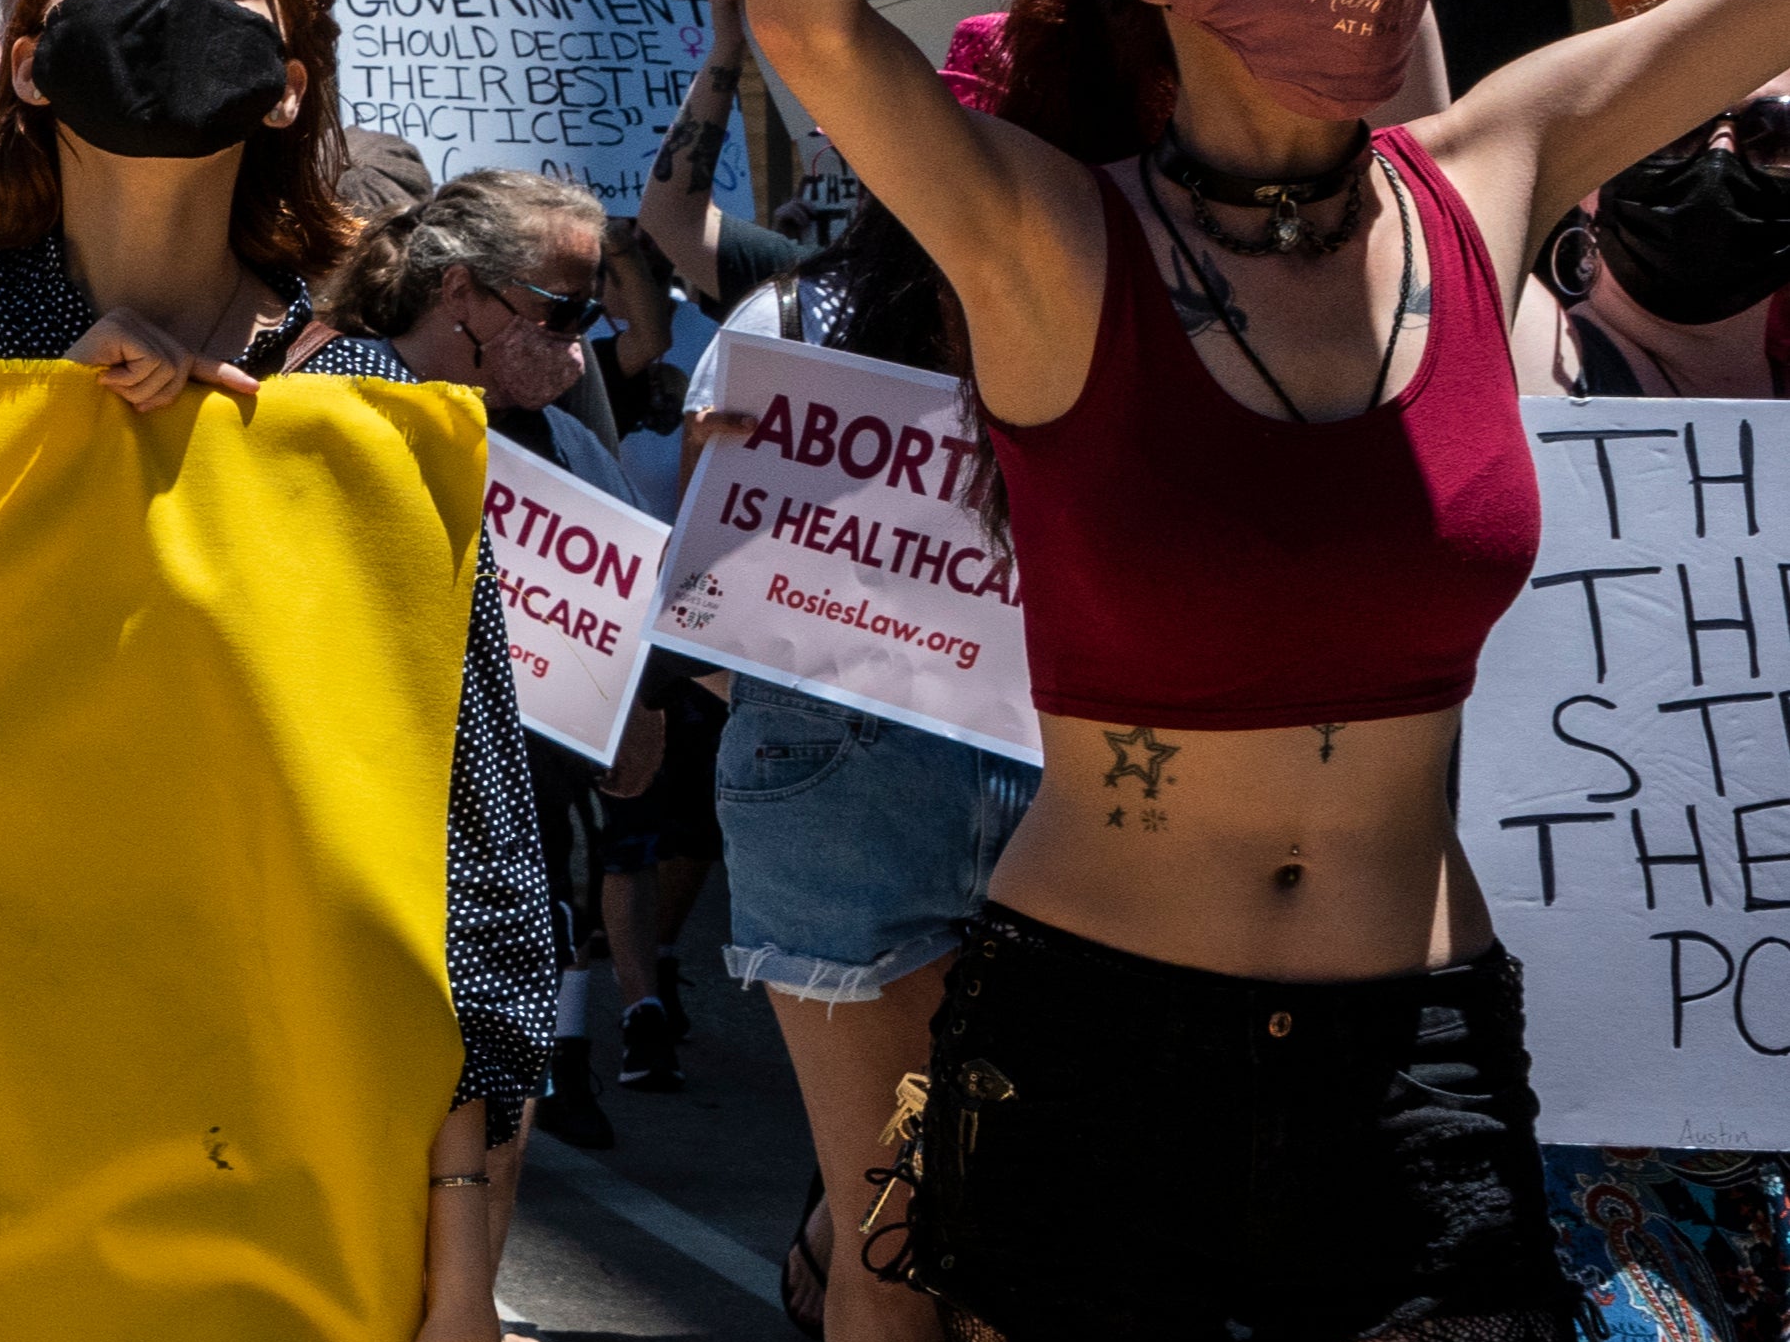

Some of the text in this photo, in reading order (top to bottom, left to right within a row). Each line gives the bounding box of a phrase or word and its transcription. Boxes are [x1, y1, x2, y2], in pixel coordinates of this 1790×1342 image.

[352, 24, 672, 65] SHOULD DECIDE
[1333, 18, 1358, 34] AT
[352, 64, 514, 105] THEIR
[526, 65, 633, 108] BEST
[483, 479, 642, 601] RTION
[719, 481, 1024, 608] IS HEALTHCA
[765, 573, 981, 670] RosiesLaw.org
[1677, 1119, 1753, 1148] Austin
